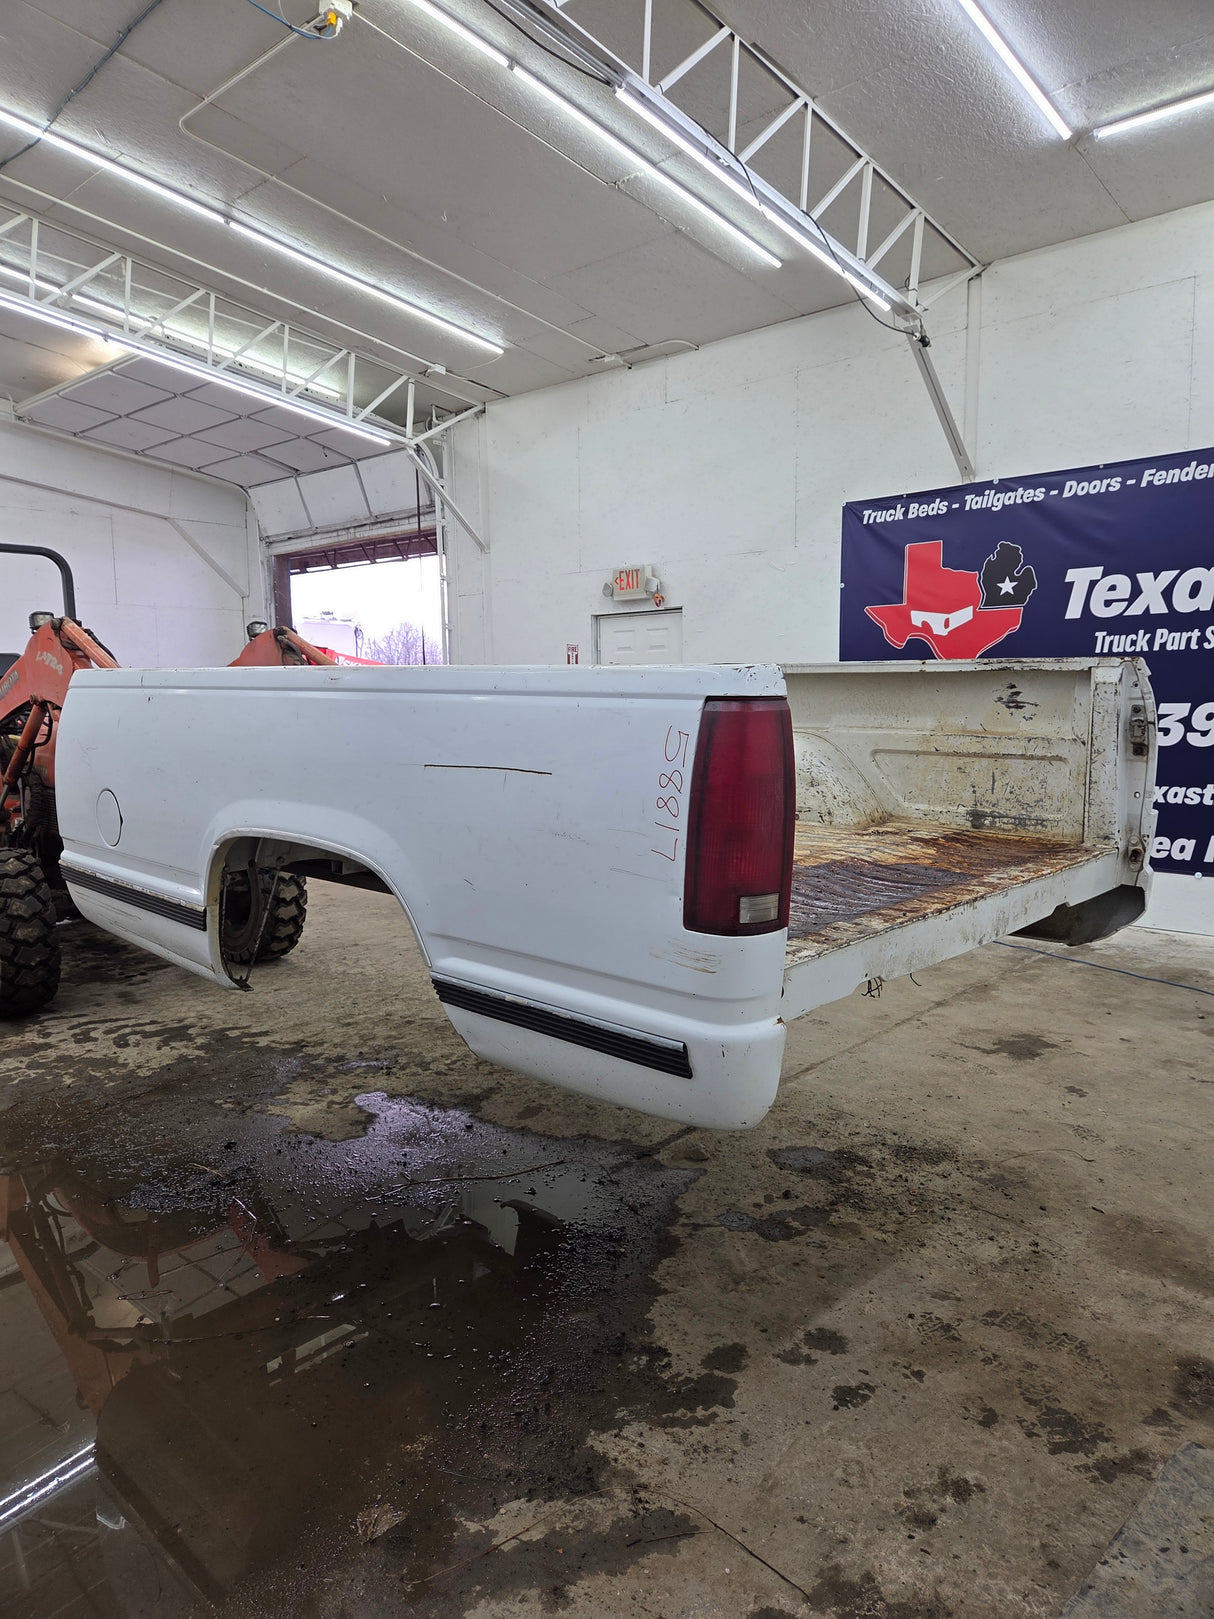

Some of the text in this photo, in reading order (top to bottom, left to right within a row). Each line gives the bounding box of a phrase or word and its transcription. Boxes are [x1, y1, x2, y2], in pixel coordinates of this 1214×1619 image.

[862, 504, 905, 525] Truck
[907, 498, 949, 519] Beds
[964, 486, 1046, 511] Tailgates
[1062, 476, 1122, 498] Doors
[619, 568, 640, 591] EXIT
[1064, 565, 1214, 620] Texa
[1094, 629, 1151, 654] Truck
[1153, 628, 1201, 651] Part
[1157, 702, 1214, 748] 39
[651, 725, 689, 861] 58817
